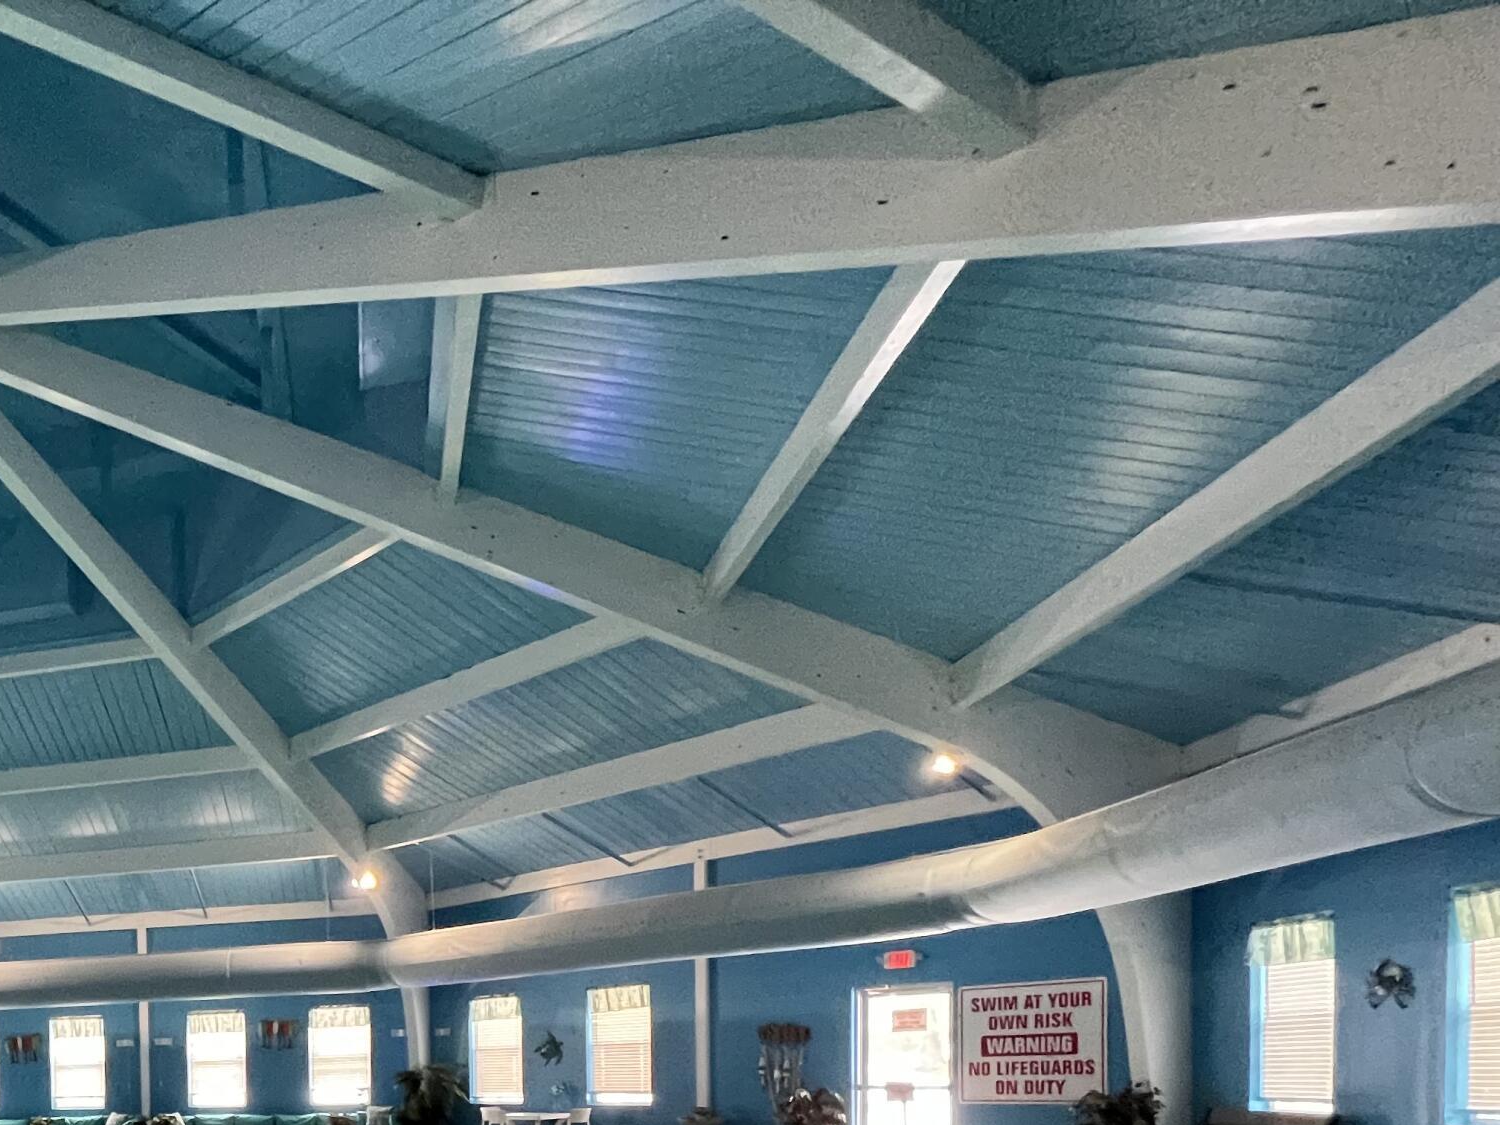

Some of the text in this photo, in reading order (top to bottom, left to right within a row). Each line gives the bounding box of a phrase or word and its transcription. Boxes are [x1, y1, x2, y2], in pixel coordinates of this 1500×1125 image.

[971, 991, 1092, 1012] SWIM AT YOUR
[988, 1012, 1073, 1030] OWN RISK
[986, 1035, 1072, 1055] WARNING
[969, 1060, 1095, 1076] NO LIFEGUARDS
[995, 1079, 1066, 1095] ON DUTY
